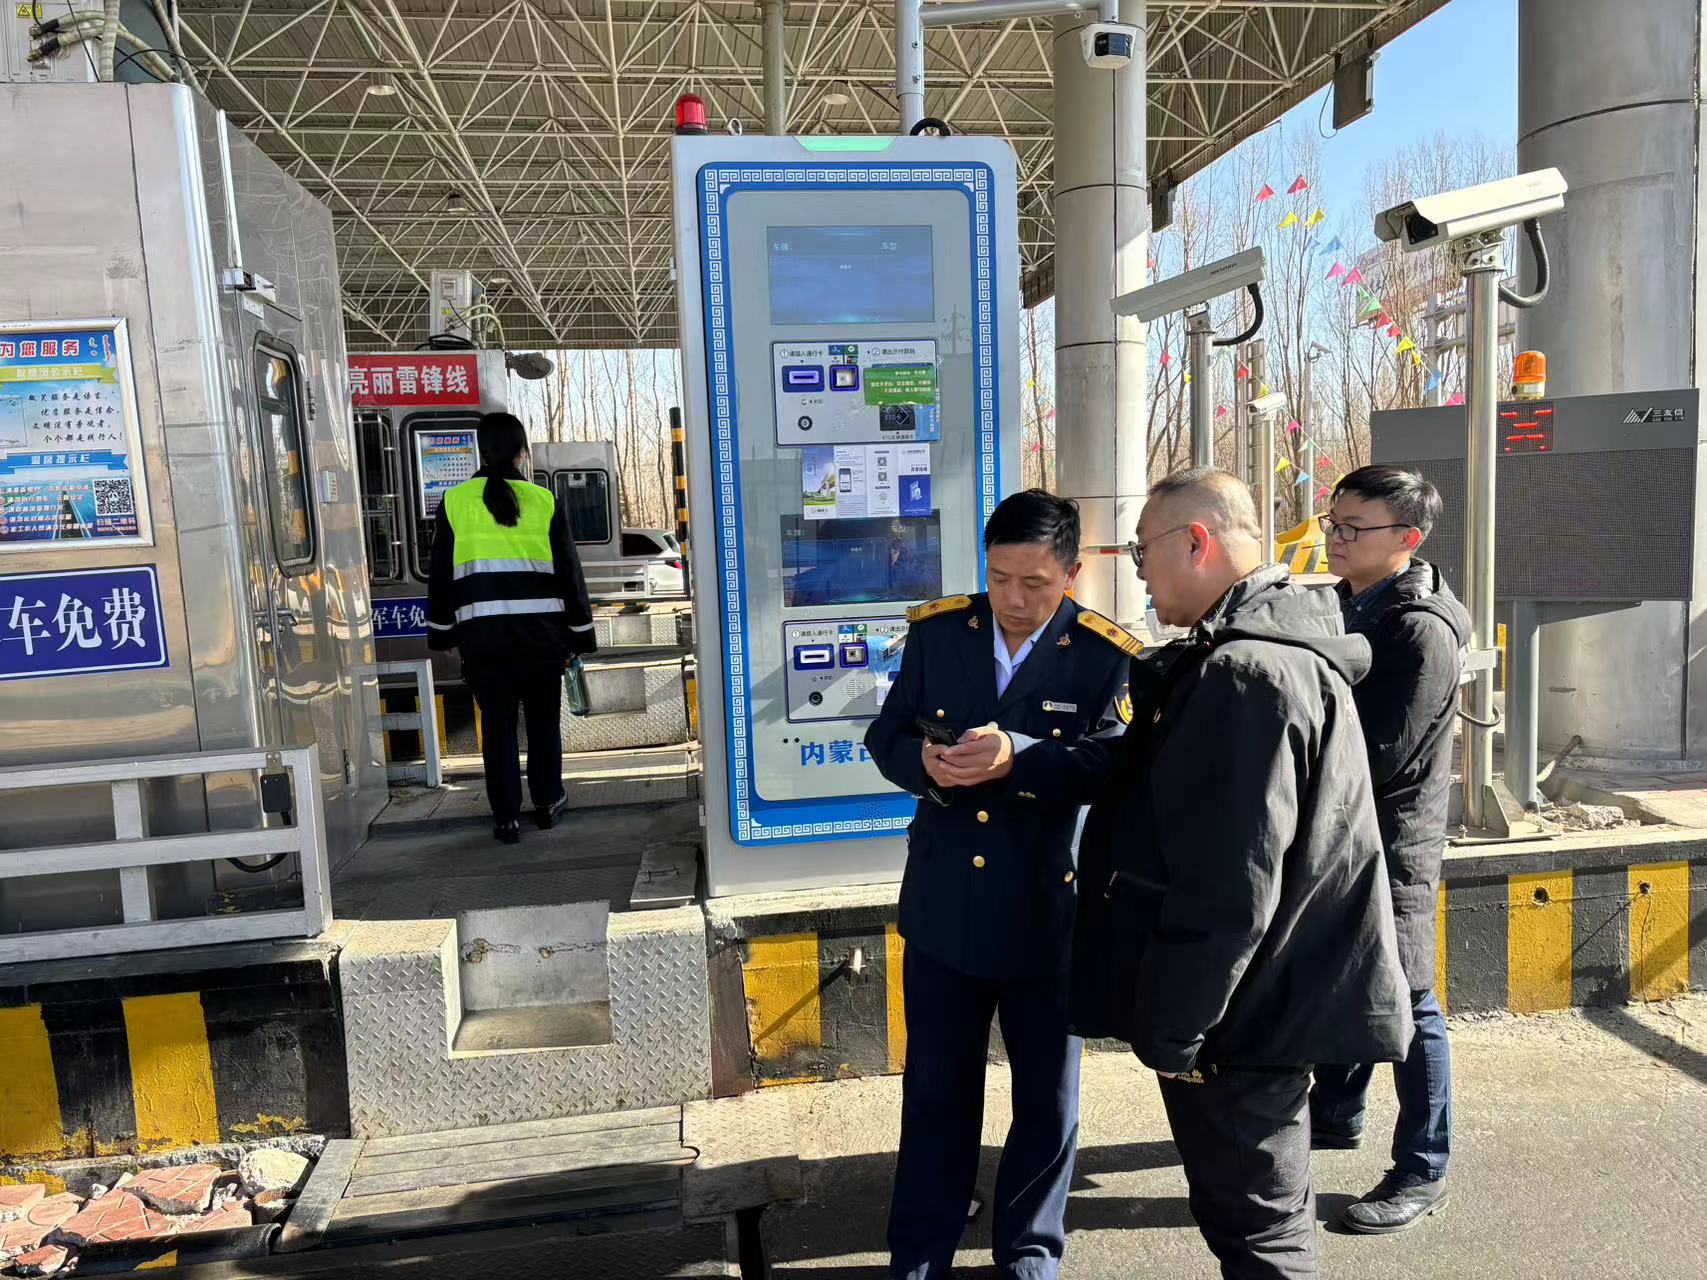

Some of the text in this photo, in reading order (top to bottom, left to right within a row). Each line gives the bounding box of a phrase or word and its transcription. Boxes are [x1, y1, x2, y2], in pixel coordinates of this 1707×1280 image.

[0, 338, 80, 359] 为您服务
[348, 365, 470, 396] 亮丽雷锋线
[1652, 408, 1684, 417] 三友信
